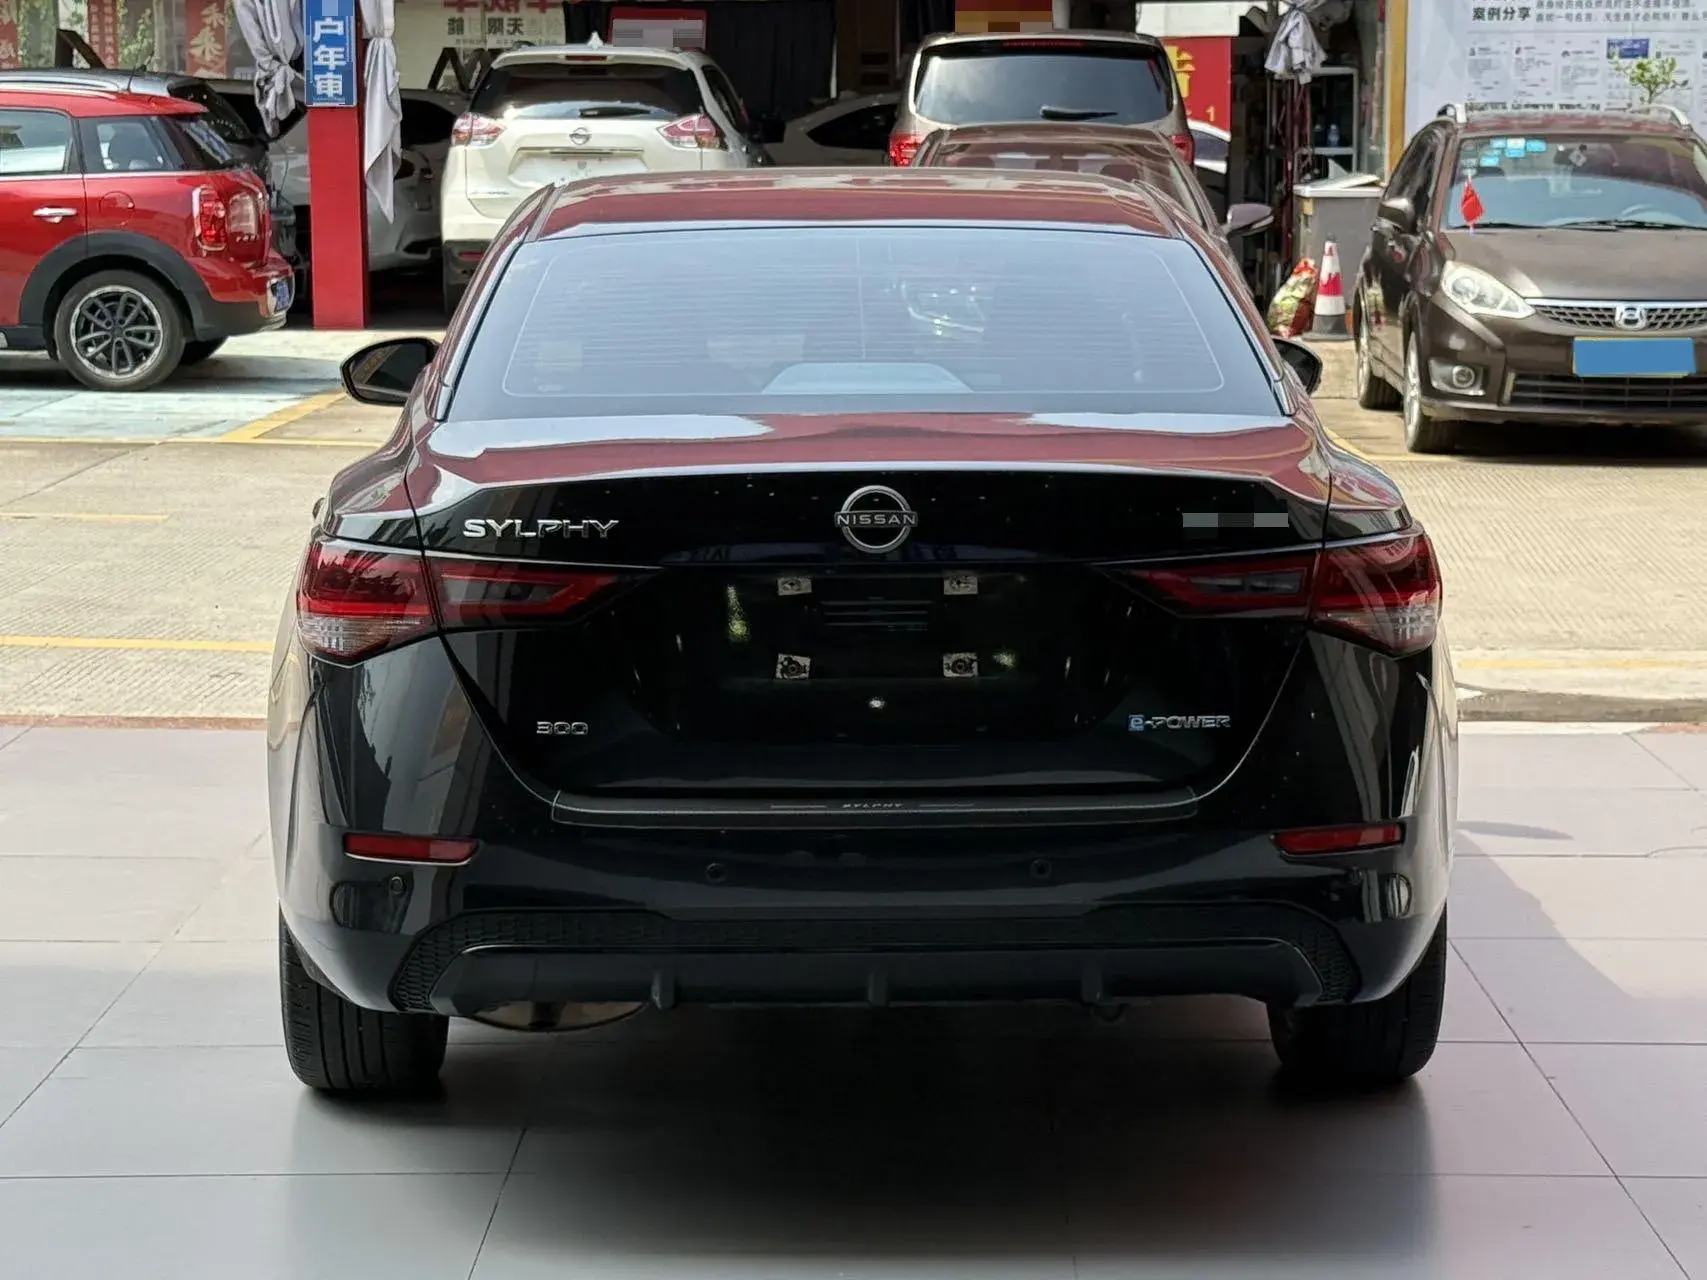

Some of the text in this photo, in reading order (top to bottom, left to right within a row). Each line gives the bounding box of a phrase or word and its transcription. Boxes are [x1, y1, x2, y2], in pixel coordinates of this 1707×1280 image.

[1472, 6, 1531, 21] 案例分享
[837, 513, 916, 525] NISSAN
[463, 519, 619, 538] SYLPHY
[536, 721, 589, 735] 300
[1128, 714, 1231, 731] e-POWER
